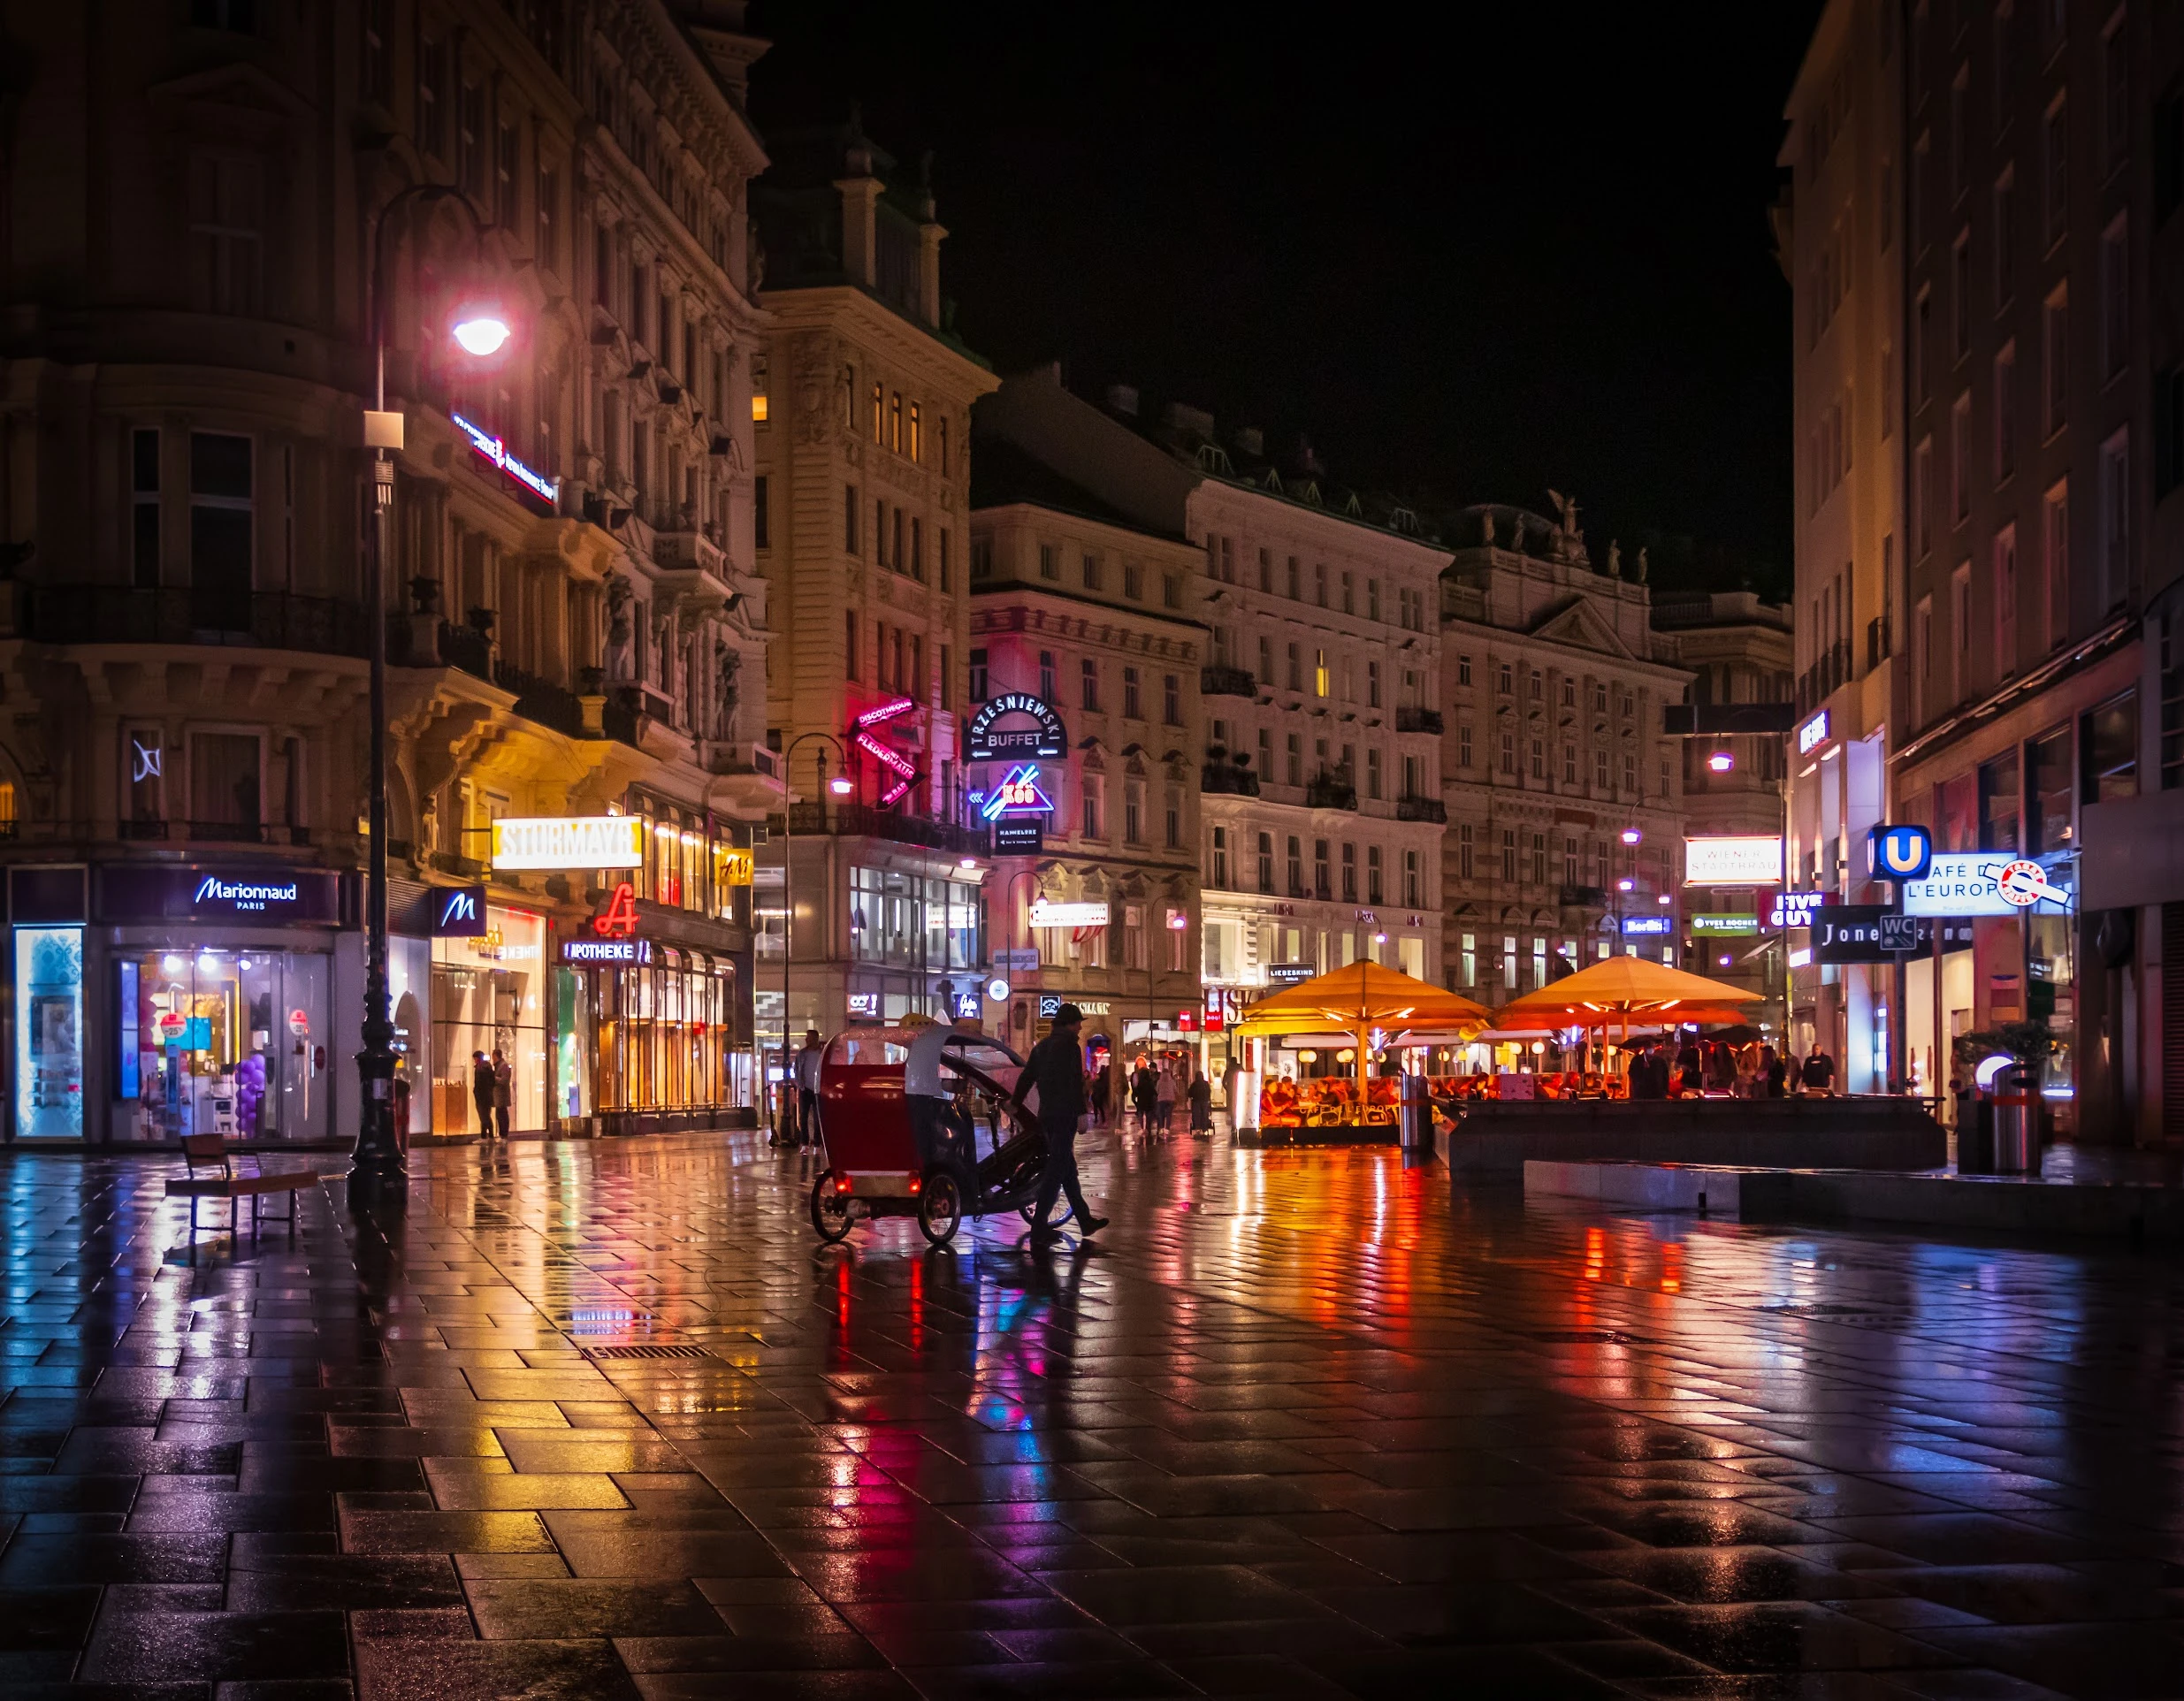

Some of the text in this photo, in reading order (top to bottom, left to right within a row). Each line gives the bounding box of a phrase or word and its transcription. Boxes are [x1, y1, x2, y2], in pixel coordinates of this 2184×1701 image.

[988, 733, 1042, 747] BUFFET
[857, 735, 914, 778] FLEDERMAUS
[890, 781, 906, 797] BAR
[500, 821, 632, 856] STURMAYR
[1707, 850, 1760, 859] WIENER
[1886, 835, 1922, 873] U
[1932, 863, 1966, 878] AFÉ
[195, 877, 297, 904] Marionnaud
[1908, 883, 1997, 897] L'EUROP
[236, 901, 265, 910] PARIS
[1770, 911, 1812, 926] GUY
[1883, 919, 1913, 934] WC
[1821, 924, 1880, 947] Jone
[570, 943, 634, 959] APOTHEKE
